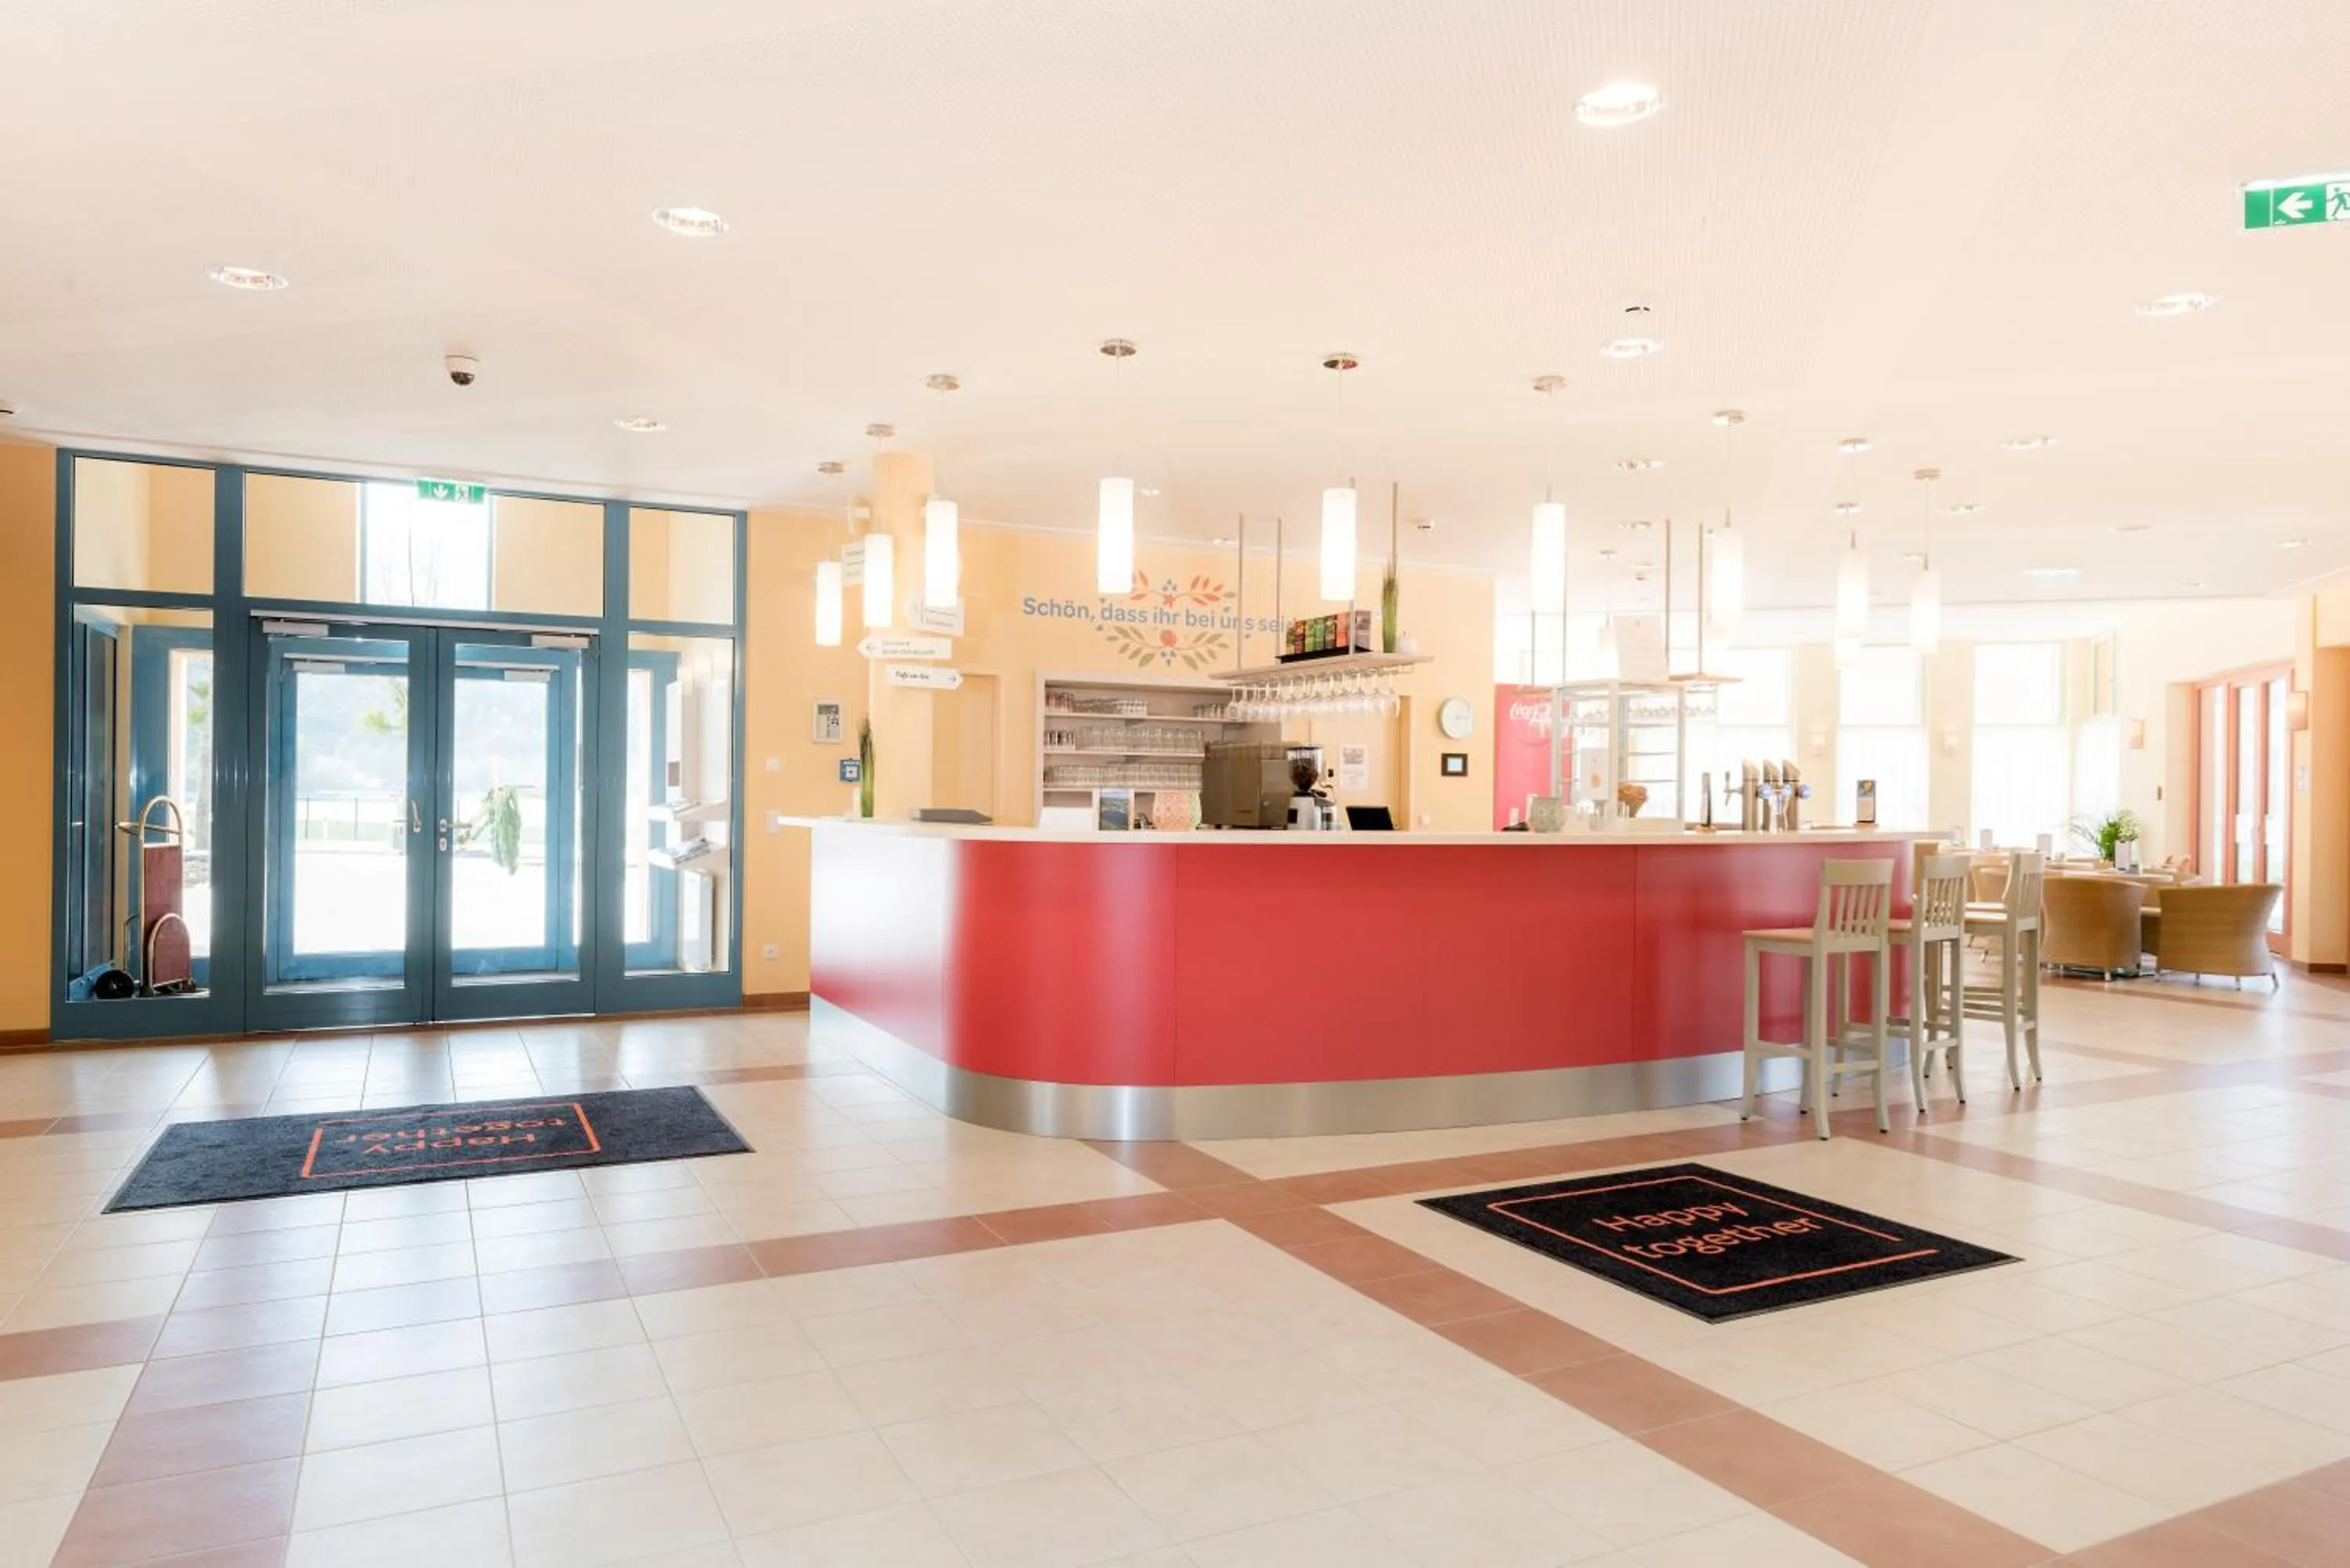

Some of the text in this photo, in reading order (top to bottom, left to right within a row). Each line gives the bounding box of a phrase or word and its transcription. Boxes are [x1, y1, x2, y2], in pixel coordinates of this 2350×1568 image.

[1022, 597, 1095, 622] Schön,
[1100, 602, 1148, 624] dass
[1153, 605, 1178, 625] ihr
[1185, 609, 1214, 627] bei
[1258, 614, 1295, 633] sei
[1592, 1201, 1749, 1232] Happy
[1623, 1217, 1823, 1259] together
